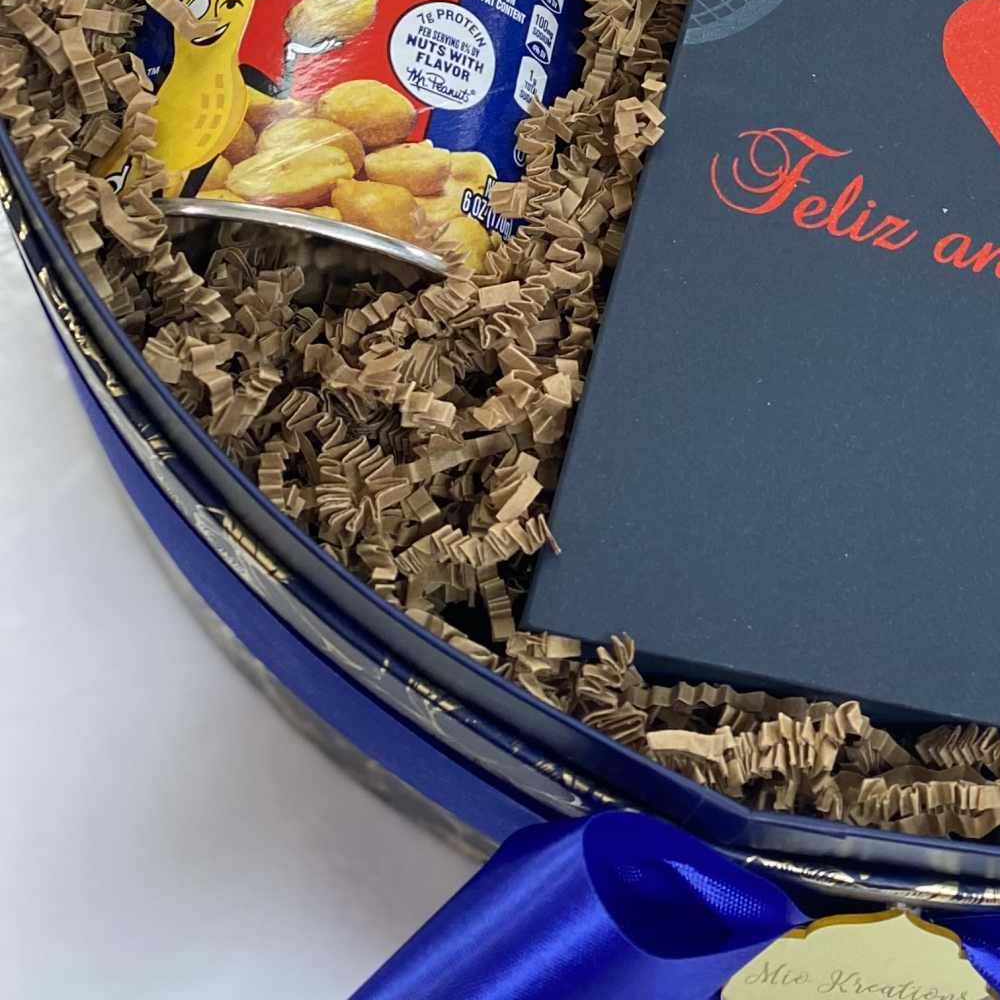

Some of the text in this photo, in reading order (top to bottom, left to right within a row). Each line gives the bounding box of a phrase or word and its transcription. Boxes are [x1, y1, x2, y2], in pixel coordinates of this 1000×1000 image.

[496, 0, 527, 25] CONTENT
[416, 8, 487, 48] 7g PROTEIN
[418, 25, 433, 39] PER
[432, 30, 460, 48] SERVING
[406, 33, 485, 74] NUTS WITH
[416, 52, 470, 82] FLAVOR
[461, 190, 472, 212] 6
[711, 126, 919, 250] Feliz
[744, 960, 810, 986] Mio
